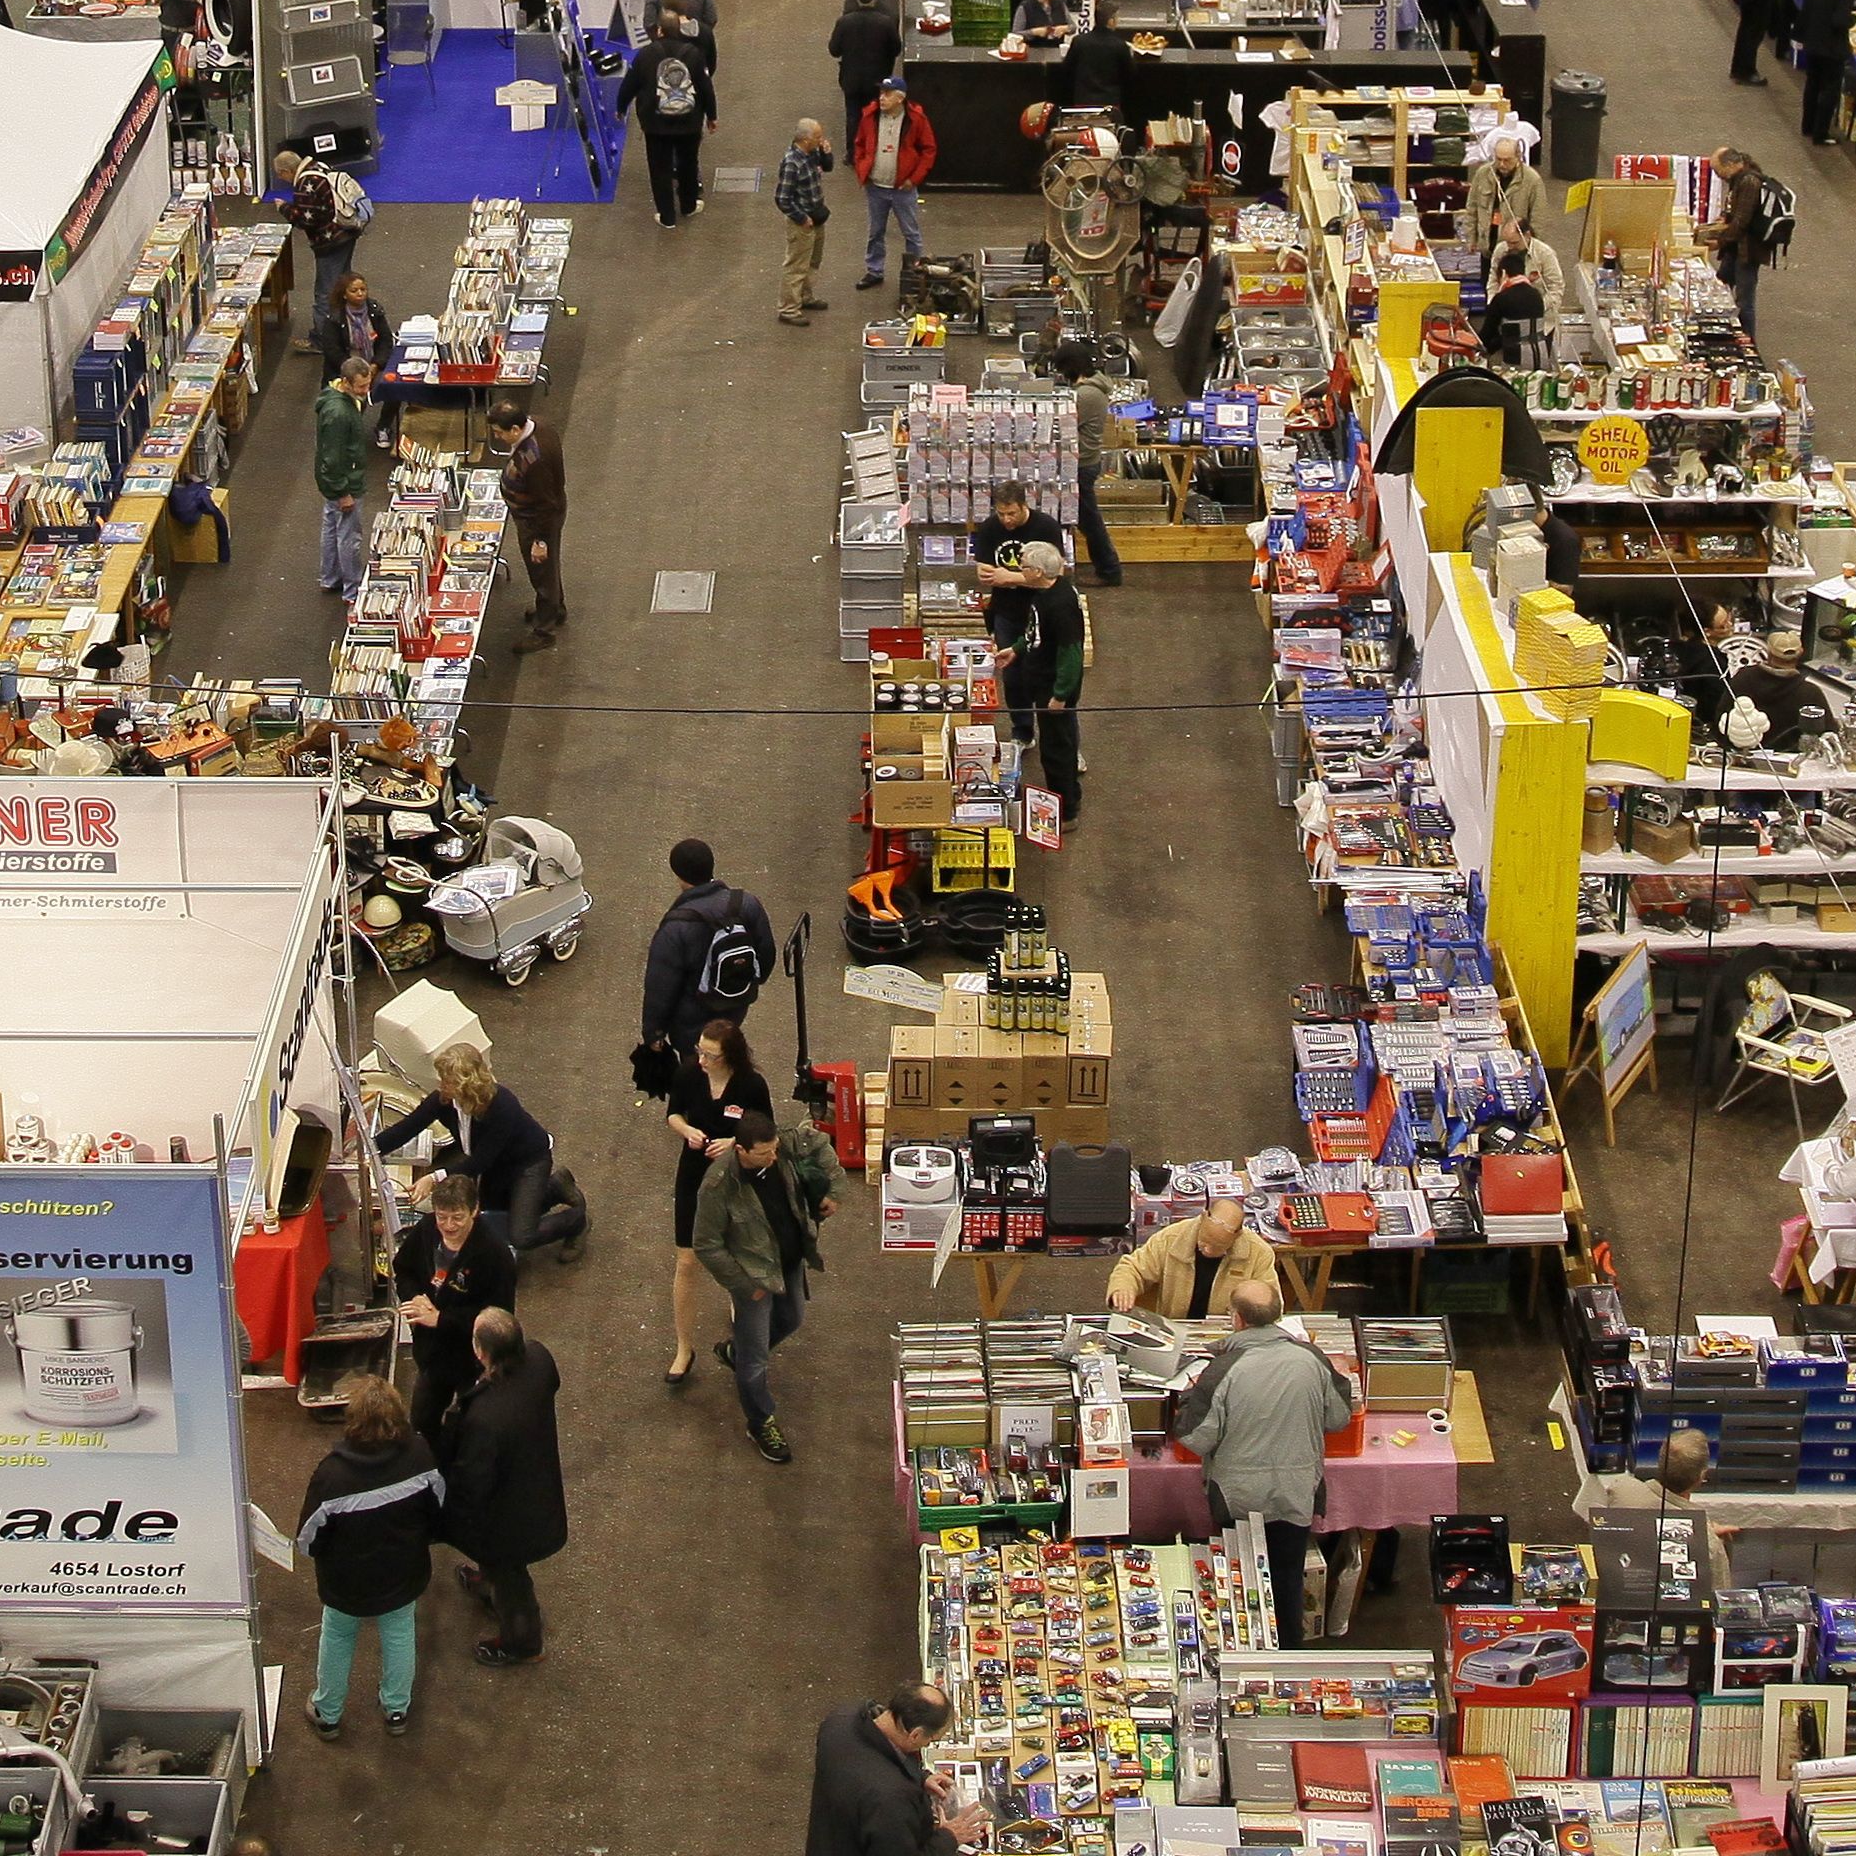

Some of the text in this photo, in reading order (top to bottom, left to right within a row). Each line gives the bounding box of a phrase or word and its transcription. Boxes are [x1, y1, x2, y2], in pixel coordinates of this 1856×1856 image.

[1589, 427, 1639, 445] SHELL
[1587, 447, 1639, 460] MOTOR
[1601, 461, 1623, 474] OIL
[40, 1366, 113, 1378] KORROSIONS-
[40, 1375, 116, 1387] SCHUTZFETT
[1013, 1418, 1039, 1426] PREIS
[35, 1430, 109, 1448] E-Mail,
[50, 1561, 186, 1577] 4654 Lostorf
[1303, 1784, 1371, 1801] WORKSHOP
[1304, 1790, 1372, 1808] MANUAL
[1487, 1798, 1533, 1813] HARLEY
[1416, 1806, 1450, 1820] BENZ
[1485, 1806, 1545, 1820] DAVIDSON
